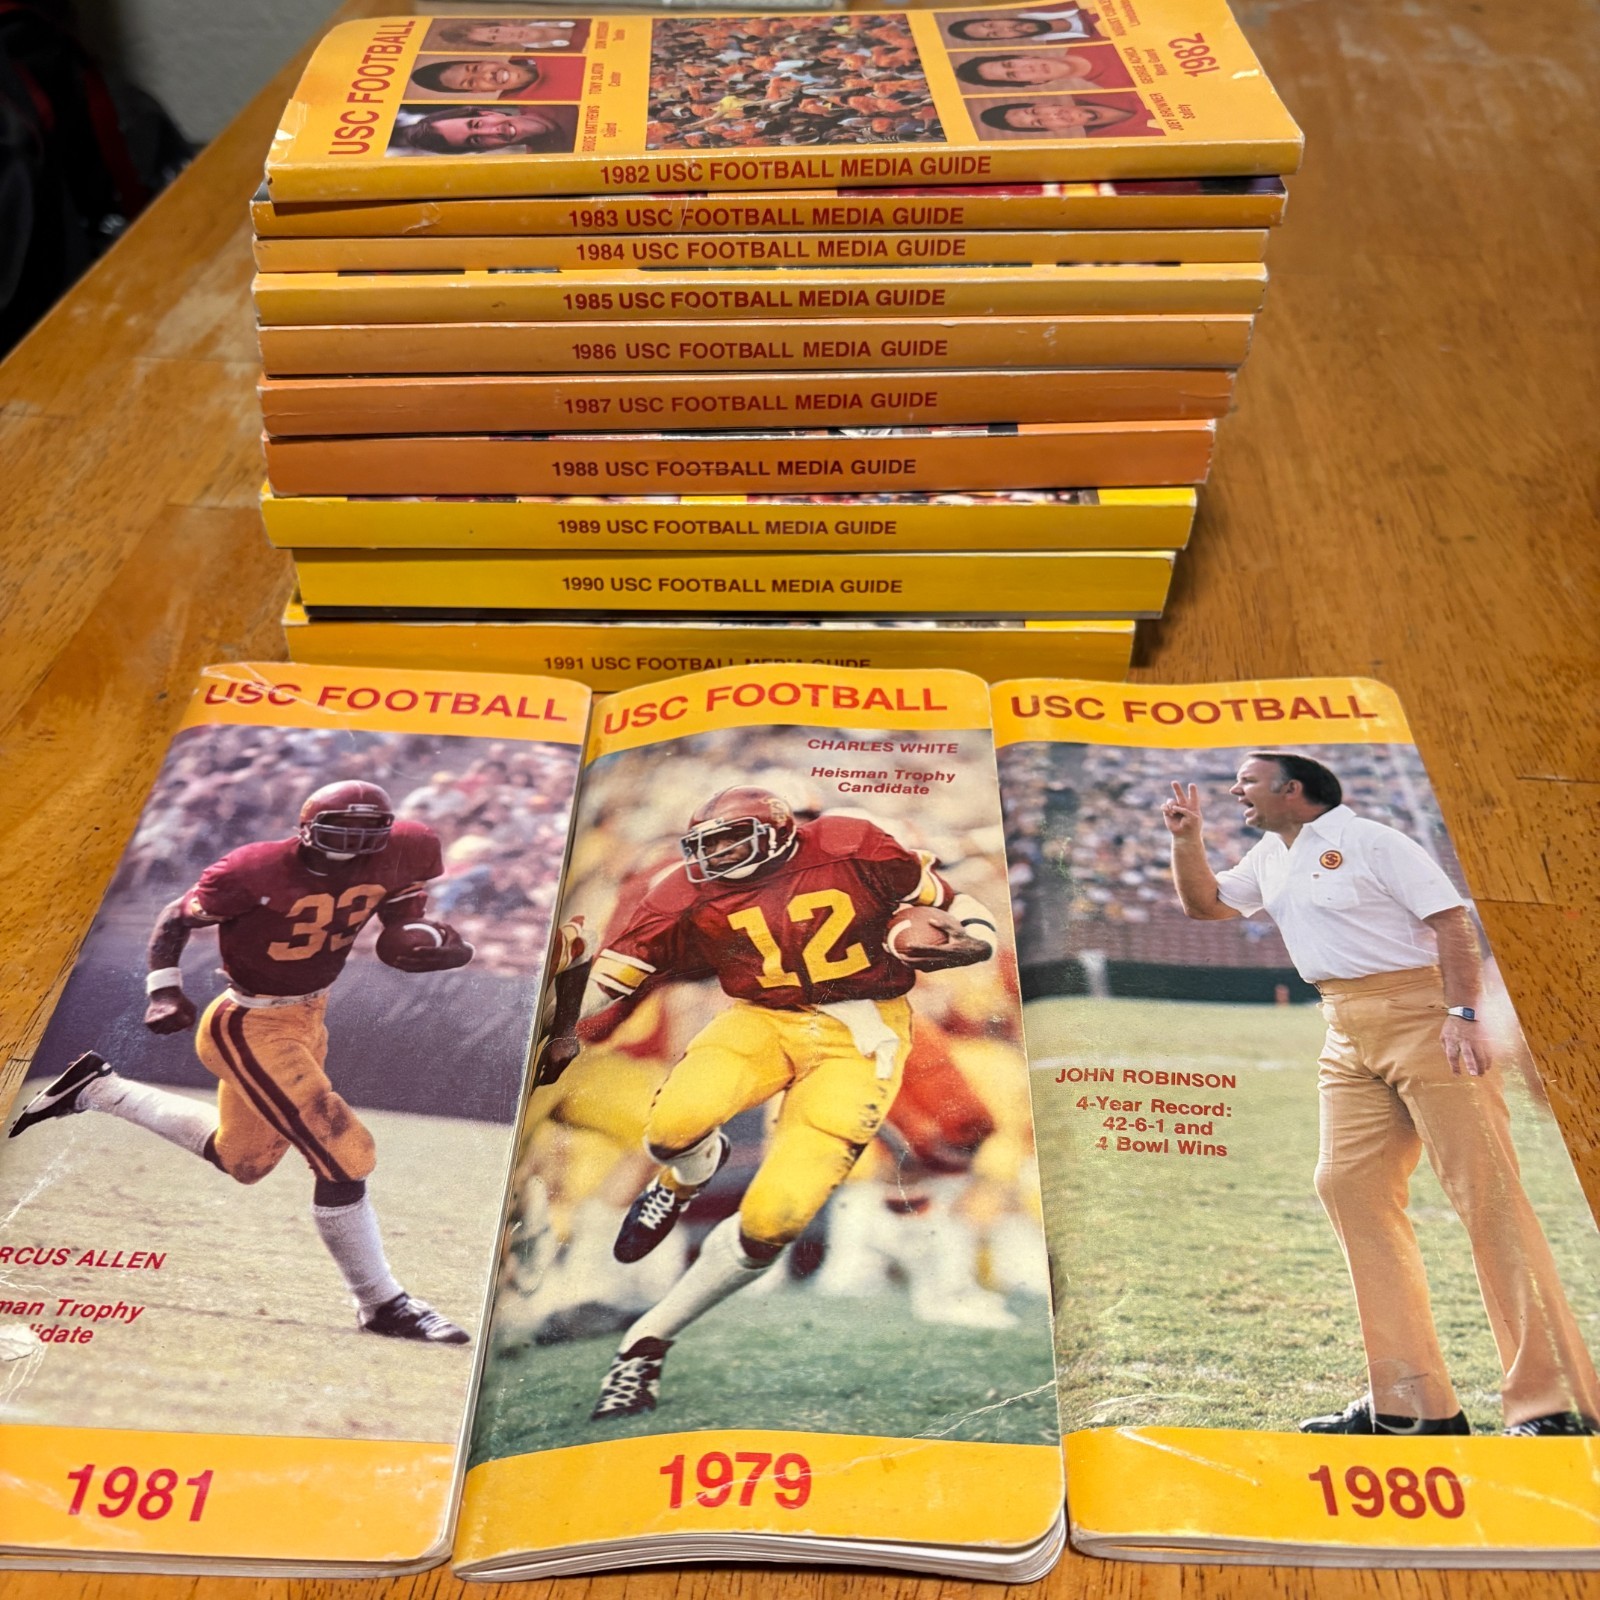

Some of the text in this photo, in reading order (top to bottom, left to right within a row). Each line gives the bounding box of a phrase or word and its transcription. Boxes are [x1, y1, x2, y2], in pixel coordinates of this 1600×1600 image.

[1168, 33, 1220, 77] 1982
[328, 20, 416, 155] USC FOOTBALL
[1149, 92, 1185, 131] JOEY BROWNER
[582, 105, 600, 152] BRUCE MATTHEWS
[601, 156, 991, 184] 1982 USC FOOTBALL MEDIA GUIDE
[569, 207, 963, 227] 1983 USC FOOTBALL MEDIA GUIDE
[577, 239, 965, 260] 1984 USC FOOTBALL MEDIA GUIDE
[563, 289, 945, 310] 1985 USC FOOTBALL MEDIA GUIDE
[572, 340, 947, 360] 1986 USC FOOTBALL MEDIA GUIDE
[564, 392, 937, 414] 1987 USC FOOTBALL MEDIA GUIDE
[552, 460, 916, 477] 1988 USC FOOTBALL MEDIA GUIDE
[558, 520, 897, 535] 1989 USC FOOTBALL MEDIA GUIDE
[562, 577, 902, 593] 1990 USC FOOTBALL MEDIA GUIDE
[544, 658, 584, 670] 1991
[591, 658, 631, 670] USC
[205, 683, 568, 722] USC FOOTBALL
[603, 682, 948, 735] USC FOOTBALL
[1011, 694, 1379, 725] USC FOOTBALL
[807, 739, 958, 754] CHARLES WHITE
[811, 767, 956, 783] Heisman Trophy
[838, 782, 930, 795] Candidate
[267, 884, 387, 961] 33
[727, 888, 872, 989] 12
[1055, 1067, 1236, 1089] JOHN ROBINSON
[1076, 1096, 1232, 1117] 4-Year Record:
[1103, 1116, 1213, 1136] 42-6-1 and
[1095, 1136, 1228, 1157] 4 Bowl Wins
[75, 1250, 167, 1270] ALLEN
[55, 1299, 146, 1324] Trophy
[659, 1452, 812, 1510] 1979
[1308, 1465, 1466, 1519] 1980
[67, 1464, 214, 1522] 1981
